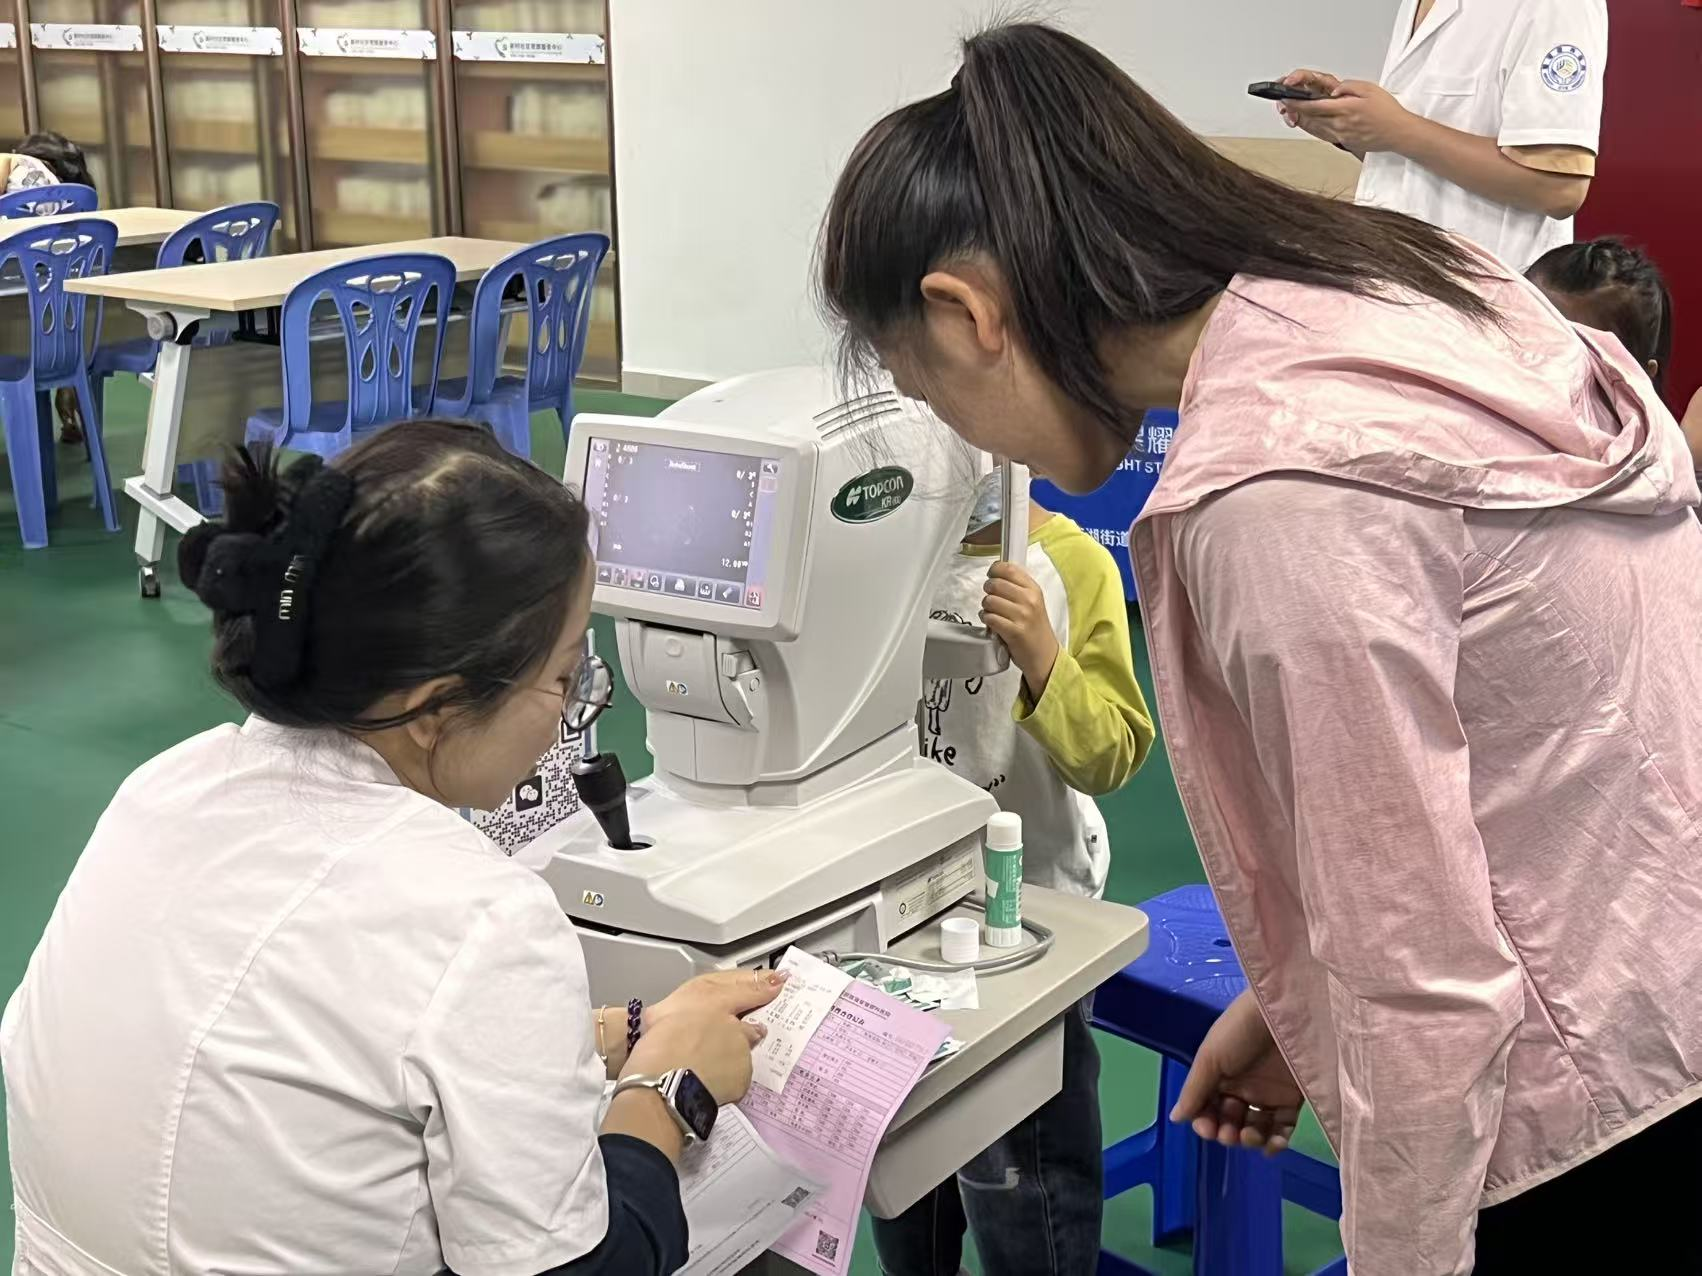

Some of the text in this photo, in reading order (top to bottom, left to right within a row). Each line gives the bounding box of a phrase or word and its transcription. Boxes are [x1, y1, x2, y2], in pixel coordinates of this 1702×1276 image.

[862, 475, 904, 500] TOPCON
[1081, 527, 1130, 547] 湖街道
[920, 736, 957, 767] ike
